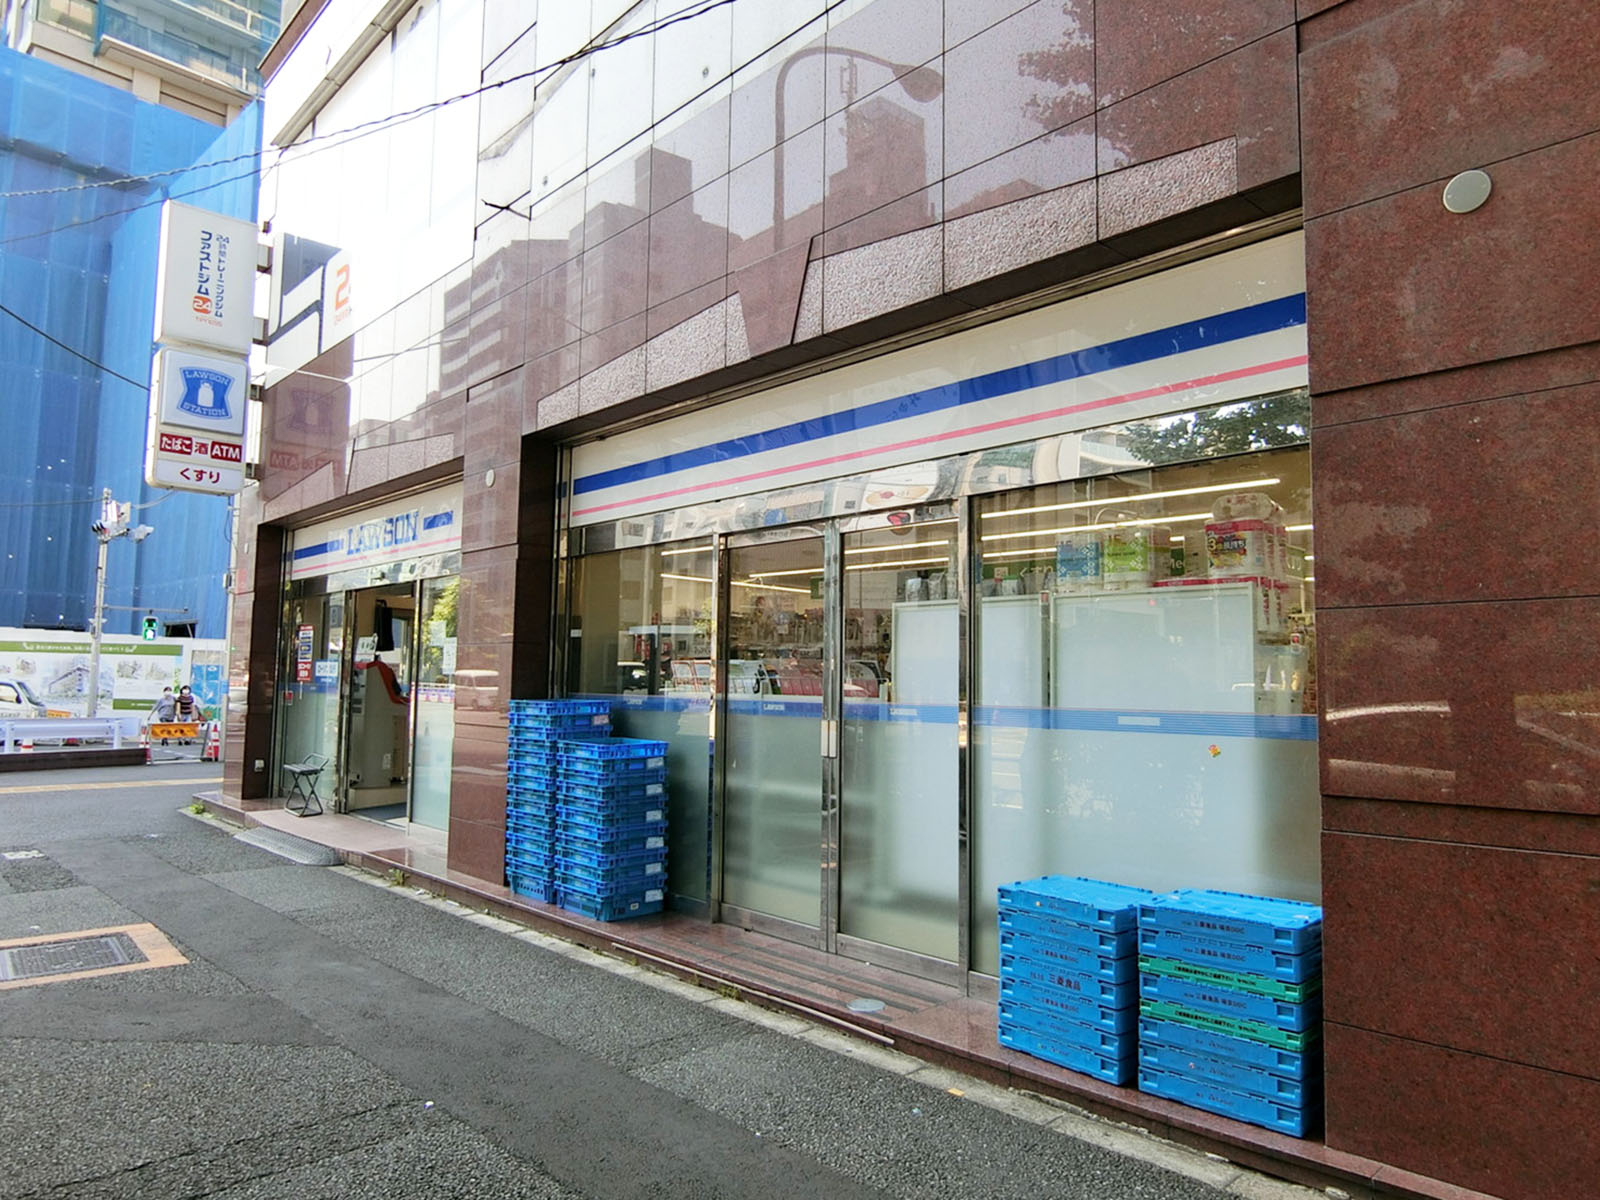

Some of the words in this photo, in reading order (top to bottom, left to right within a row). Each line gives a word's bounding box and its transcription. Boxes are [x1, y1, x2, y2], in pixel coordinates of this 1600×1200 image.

[184, 369, 230, 385] LAWSON
[182, 401, 226, 417] STATION
[160, 434, 192, 453] たばこ
[194, 439, 208, 455] 酒
[211, 444, 241, 461] ATM
[179, 467, 220, 484] くすり
[346, 511, 419, 555] LAWSON
